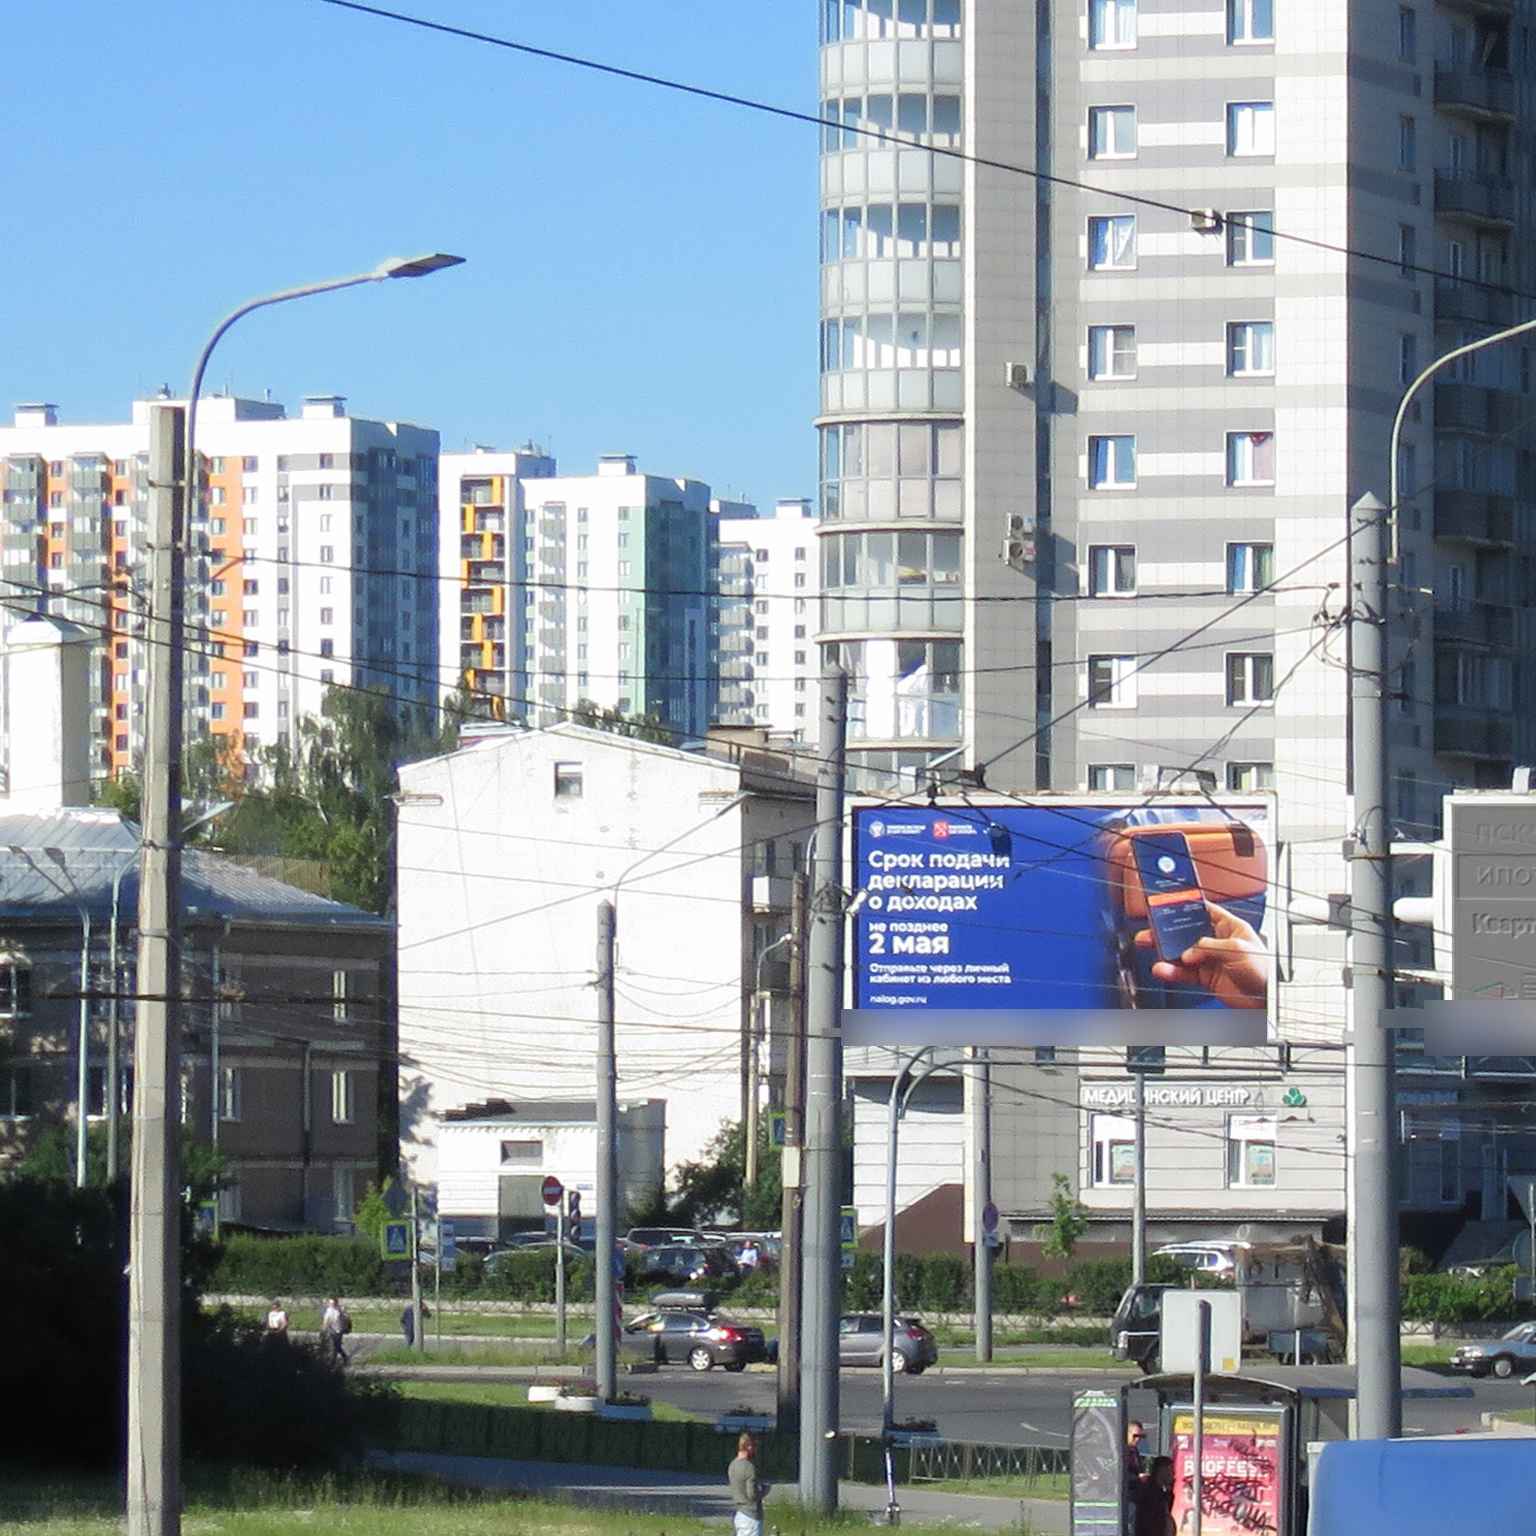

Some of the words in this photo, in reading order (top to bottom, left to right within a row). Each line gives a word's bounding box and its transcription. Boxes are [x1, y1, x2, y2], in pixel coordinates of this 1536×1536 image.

[868, 850, 924, 871] Срок
[929, 853, 1010, 870] подачи
[867, 874, 1004, 892] декларации
[868, 896, 883, 910] о
[887, 896, 978, 912] доходах
[869, 922, 886, 932] не
[890, 922, 948, 933] позднее
[869, 933, 885, 954] 2
[893, 935, 949, 954] мая
[869, 963, 928, 974] Отправьте
[929, 964, 962, 974] через
[965, 962, 1010, 973] личный
[869, 974, 915, 984] кабинет
[918, 975, 931, 984] из
[933, 973, 975, 984] любого
[977, 975, 1012, 984] места
[870, 994, 928, 1005] nalog.gov.ru
[1085, 1087, 1200, 1107] МЕДИЦНСКИЙ
[1206, 1088, 1249, 1107] ЦЕНТР
